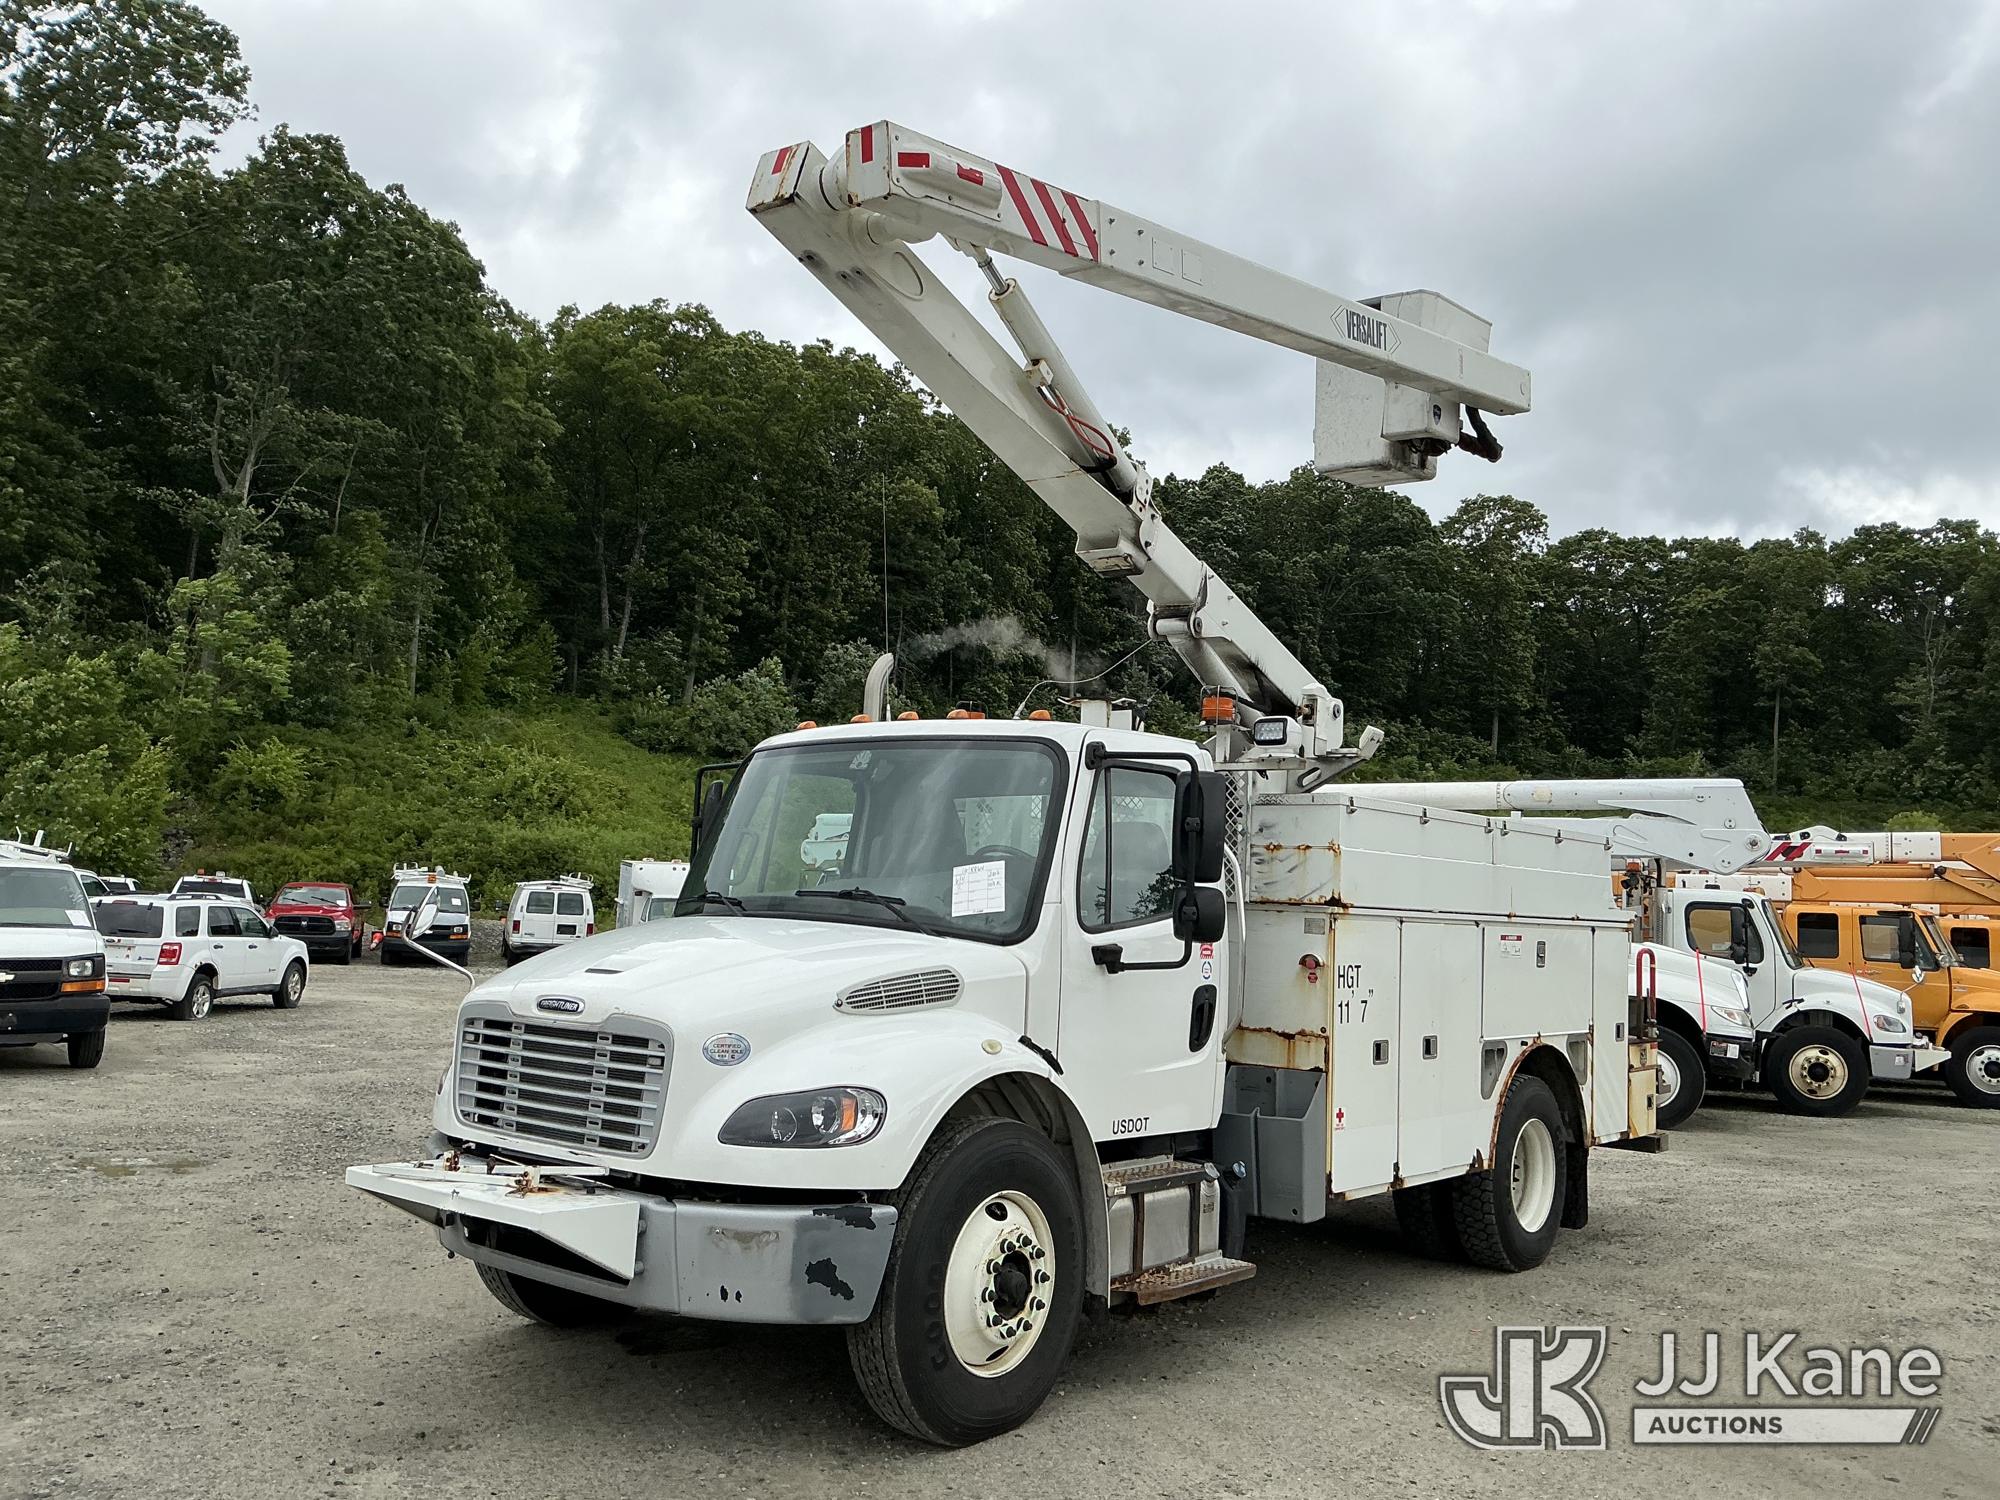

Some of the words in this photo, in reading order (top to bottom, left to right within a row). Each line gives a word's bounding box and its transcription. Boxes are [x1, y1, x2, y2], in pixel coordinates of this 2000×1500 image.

[1345, 308, 1388, 351] VERSALIFT
[1337, 964, 1362, 989] HGT
[1112, 1116, 1150, 1135] USDOT
